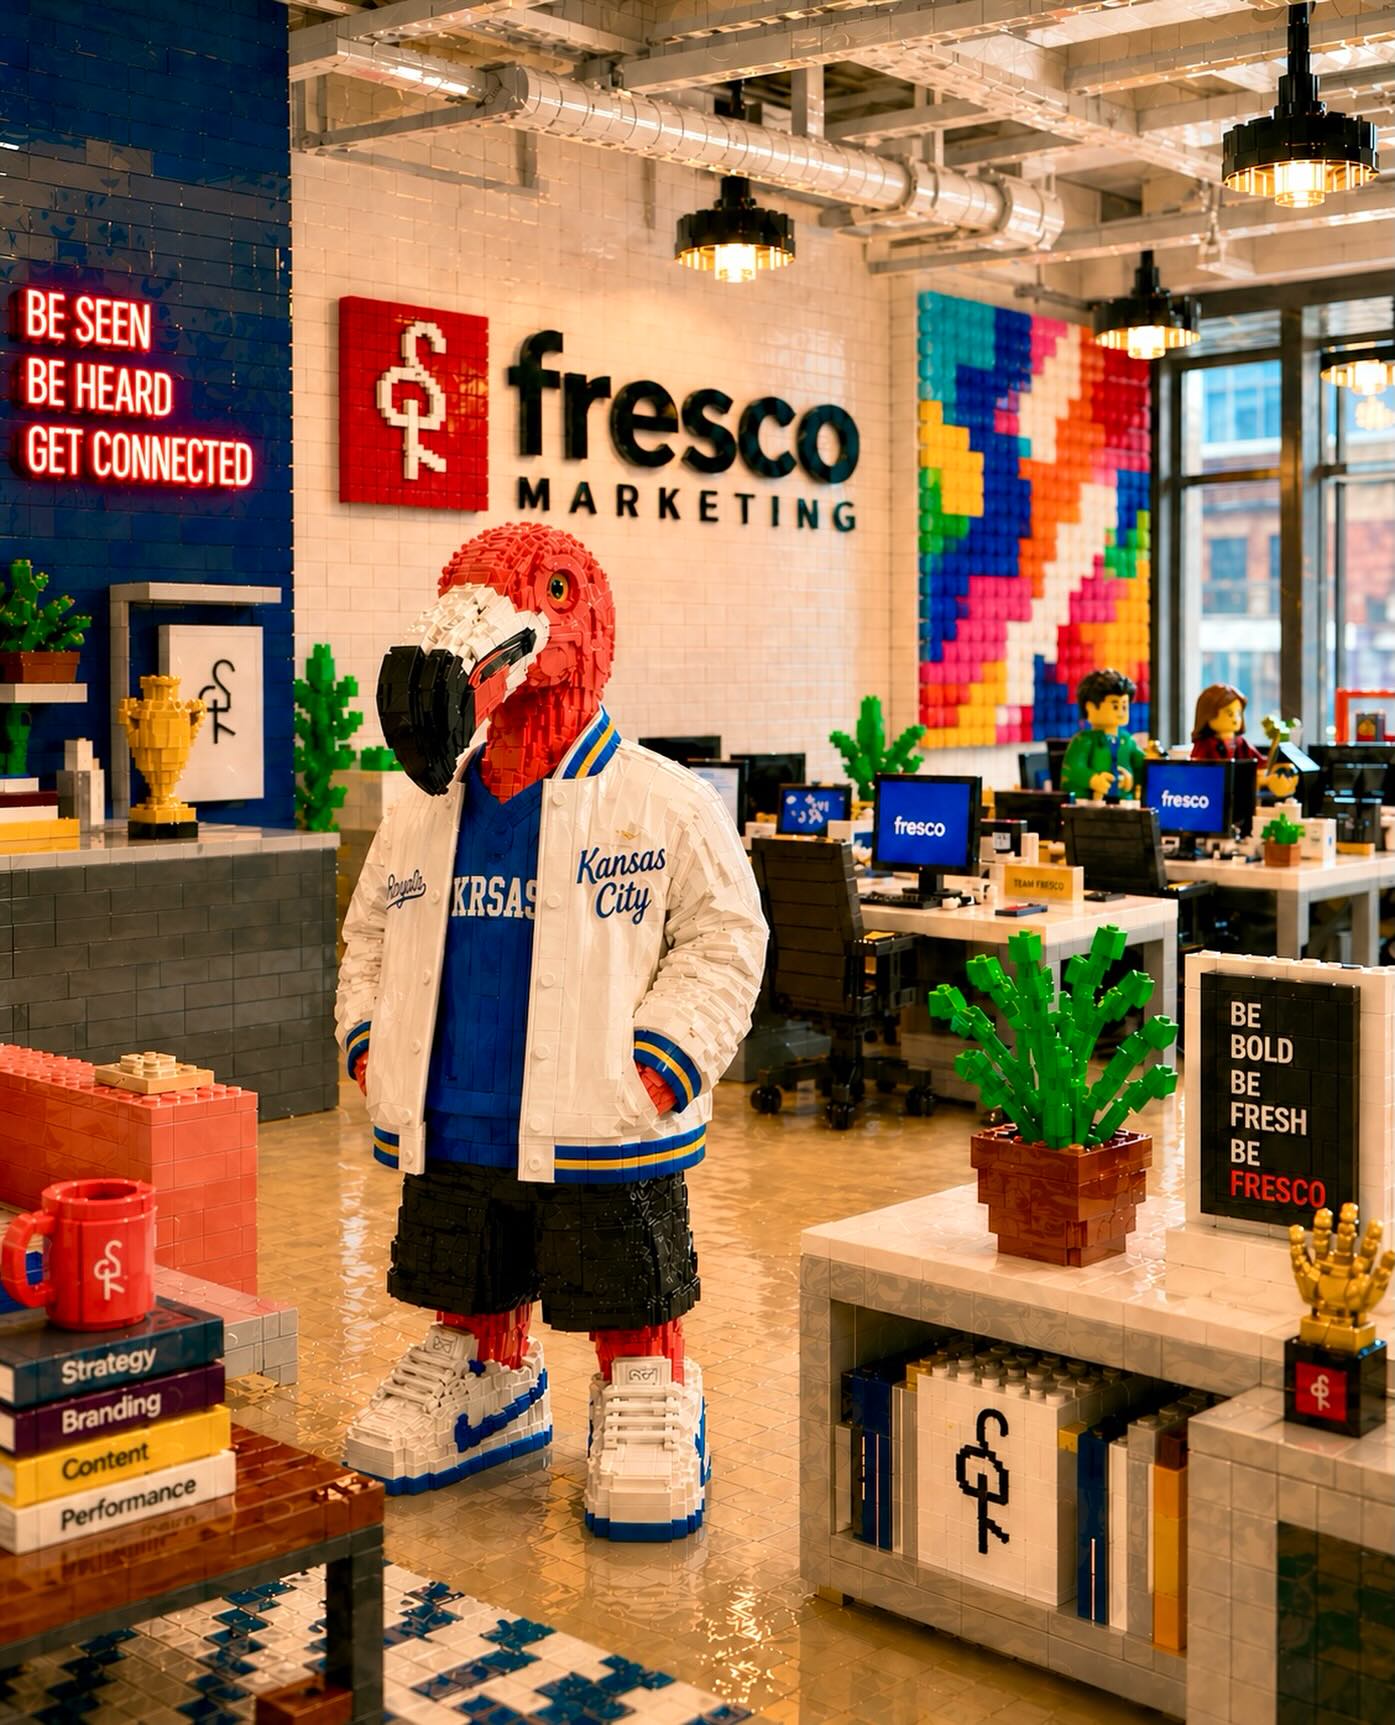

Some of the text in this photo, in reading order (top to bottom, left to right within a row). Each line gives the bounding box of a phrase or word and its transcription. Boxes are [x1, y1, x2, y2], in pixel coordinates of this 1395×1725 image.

[27, 289, 150, 349] BE SEEN
[27, 357, 172, 416] BE HEARD
[508, 330, 860, 484] fresco
[28, 425, 253, 486] GET CONNECTED
[517, 477, 857, 533] MARKETING
[1161, 790, 1209, 808] fresco
[894, 816, 945, 838] fresco
[576, 847, 666, 885] Kansas
[1014, 878, 1064, 890] TEAM FRESCO
[595, 881, 652, 925] City
[1231, 1001, 1261, 1028] BE
[1231, 1034, 1294, 1064] BOLD
[1231, 1069, 1261, 1097] BE
[1231, 1102, 1307, 1136] FRESH
[1231, 1138, 1260, 1167] BE
[1231, 1170, 1326, 1208] FRESCO
[61, 1347, 156, 1385] Strategy
[62, 1391, 162, 1434] Branding
[62, 1442, 149, 1481] Content
[60, 1477, 197, 1531] Performance
